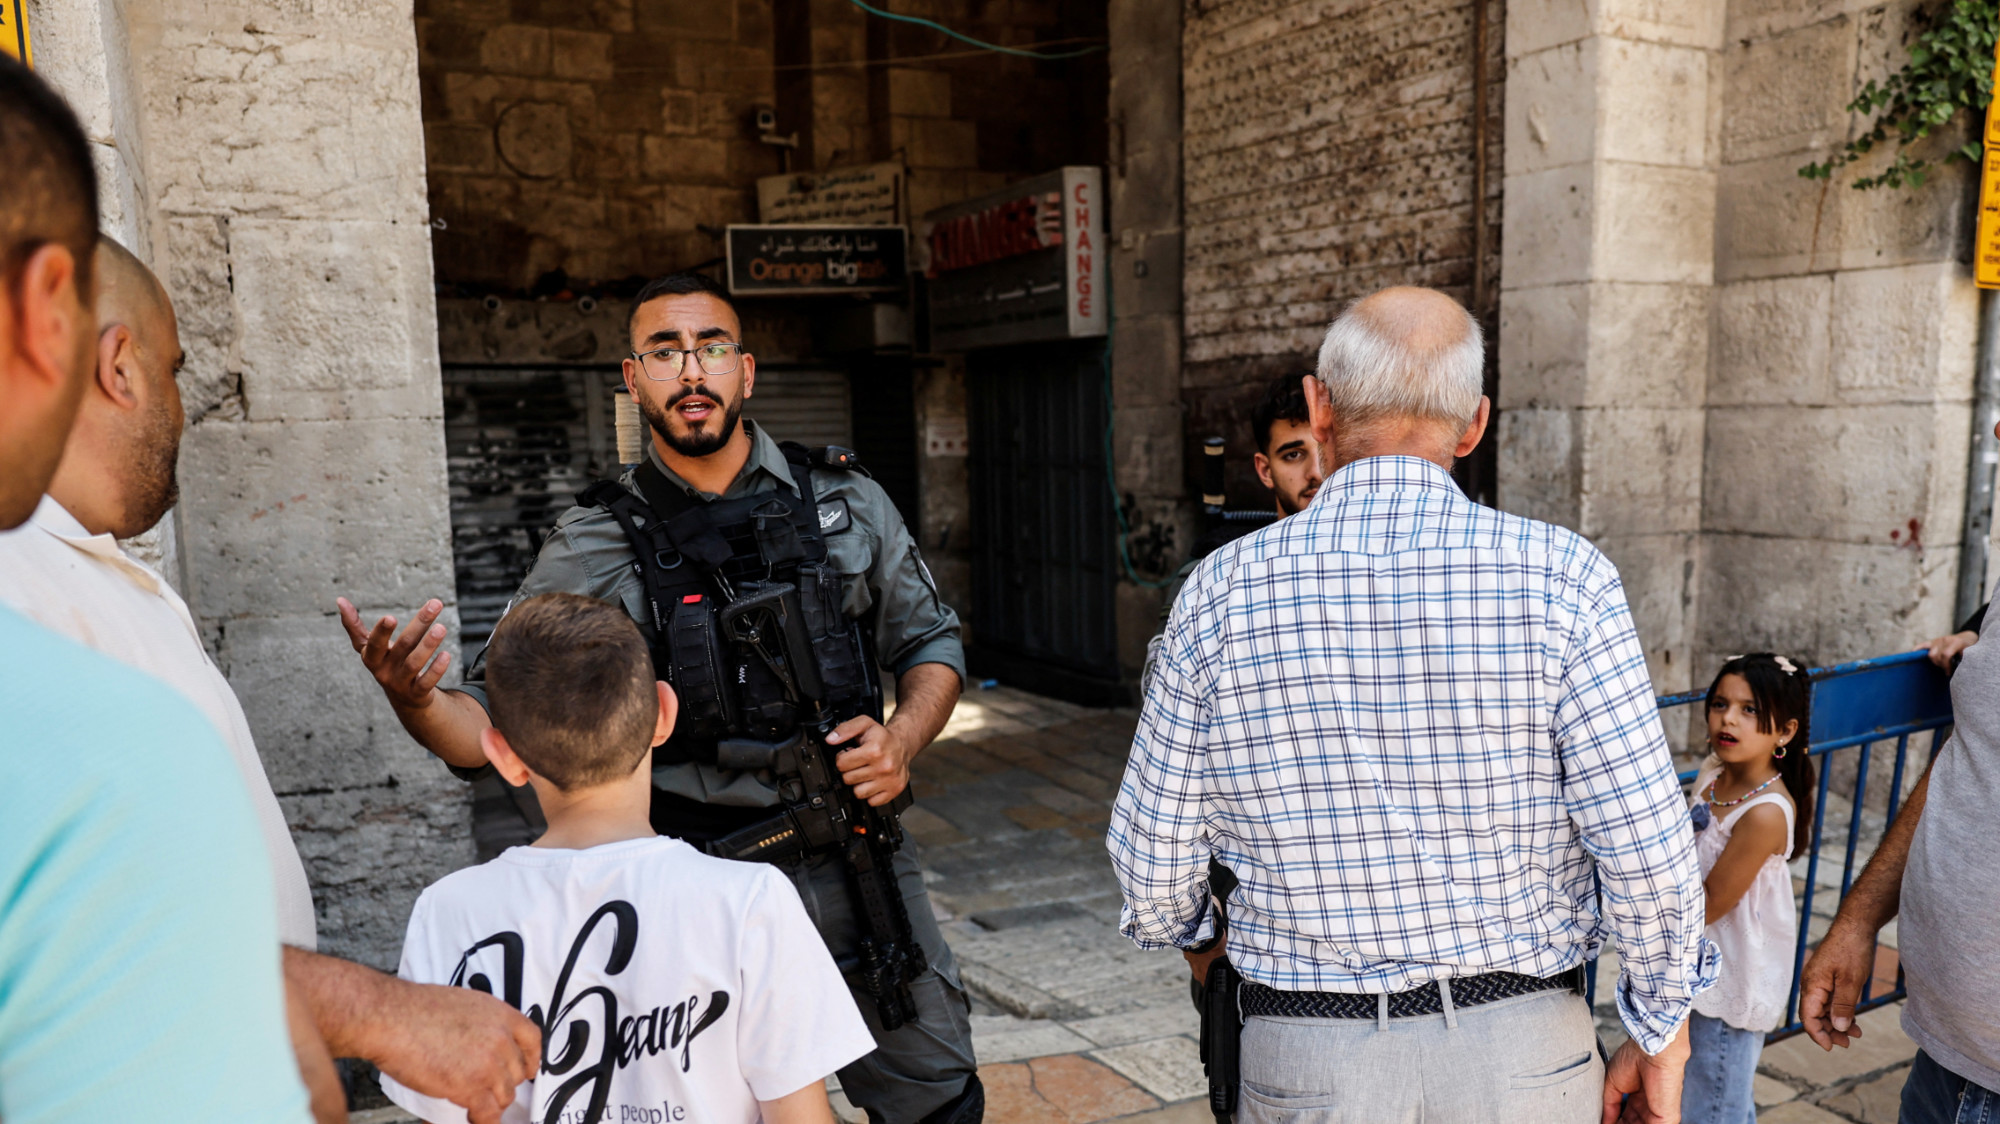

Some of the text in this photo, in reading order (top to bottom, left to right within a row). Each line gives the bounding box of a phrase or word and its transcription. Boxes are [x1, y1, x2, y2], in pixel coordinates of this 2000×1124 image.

[1073, 183, 1092, 317] CHANGE
[749, 257, 825, 285] Orange
[558, 1100, 686, 1124] rigt people
